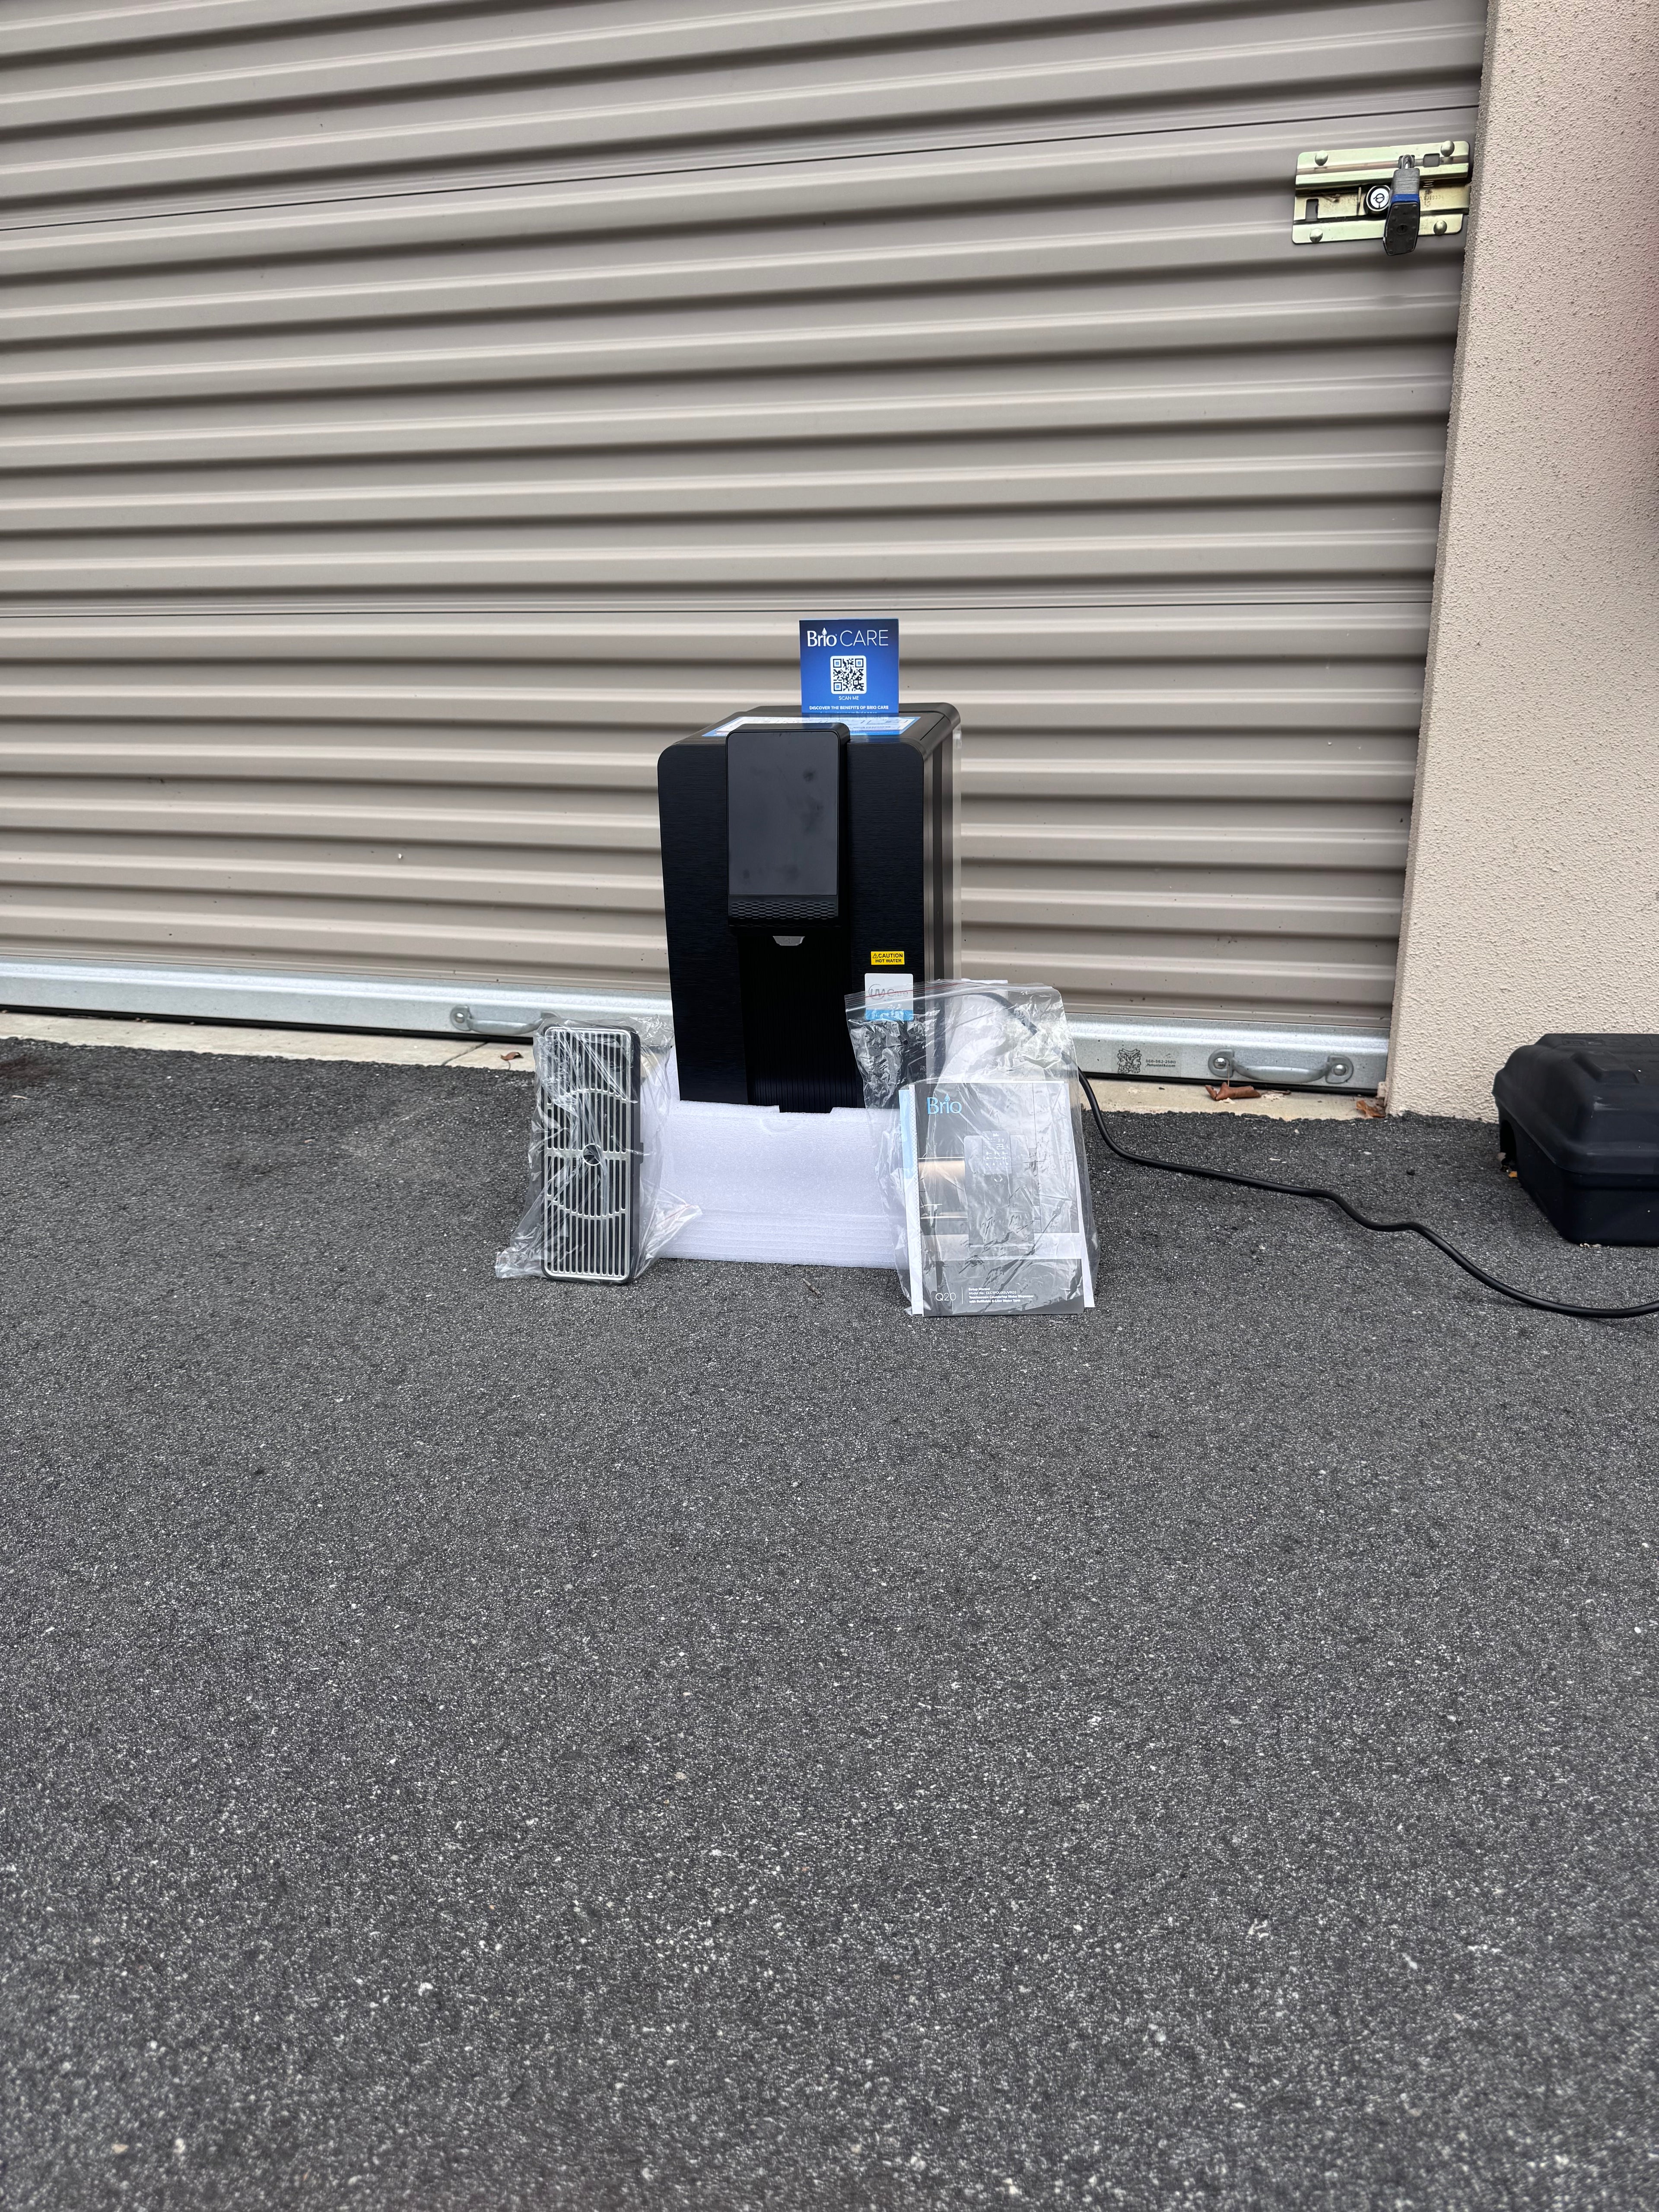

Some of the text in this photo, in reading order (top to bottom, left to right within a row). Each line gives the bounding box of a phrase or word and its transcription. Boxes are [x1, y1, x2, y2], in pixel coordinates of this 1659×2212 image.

[807, 628, 889, 647] Brio CARE
[927, 1093, 962, 1114] Brio
[935, 1292, 956, 1301] Q20
